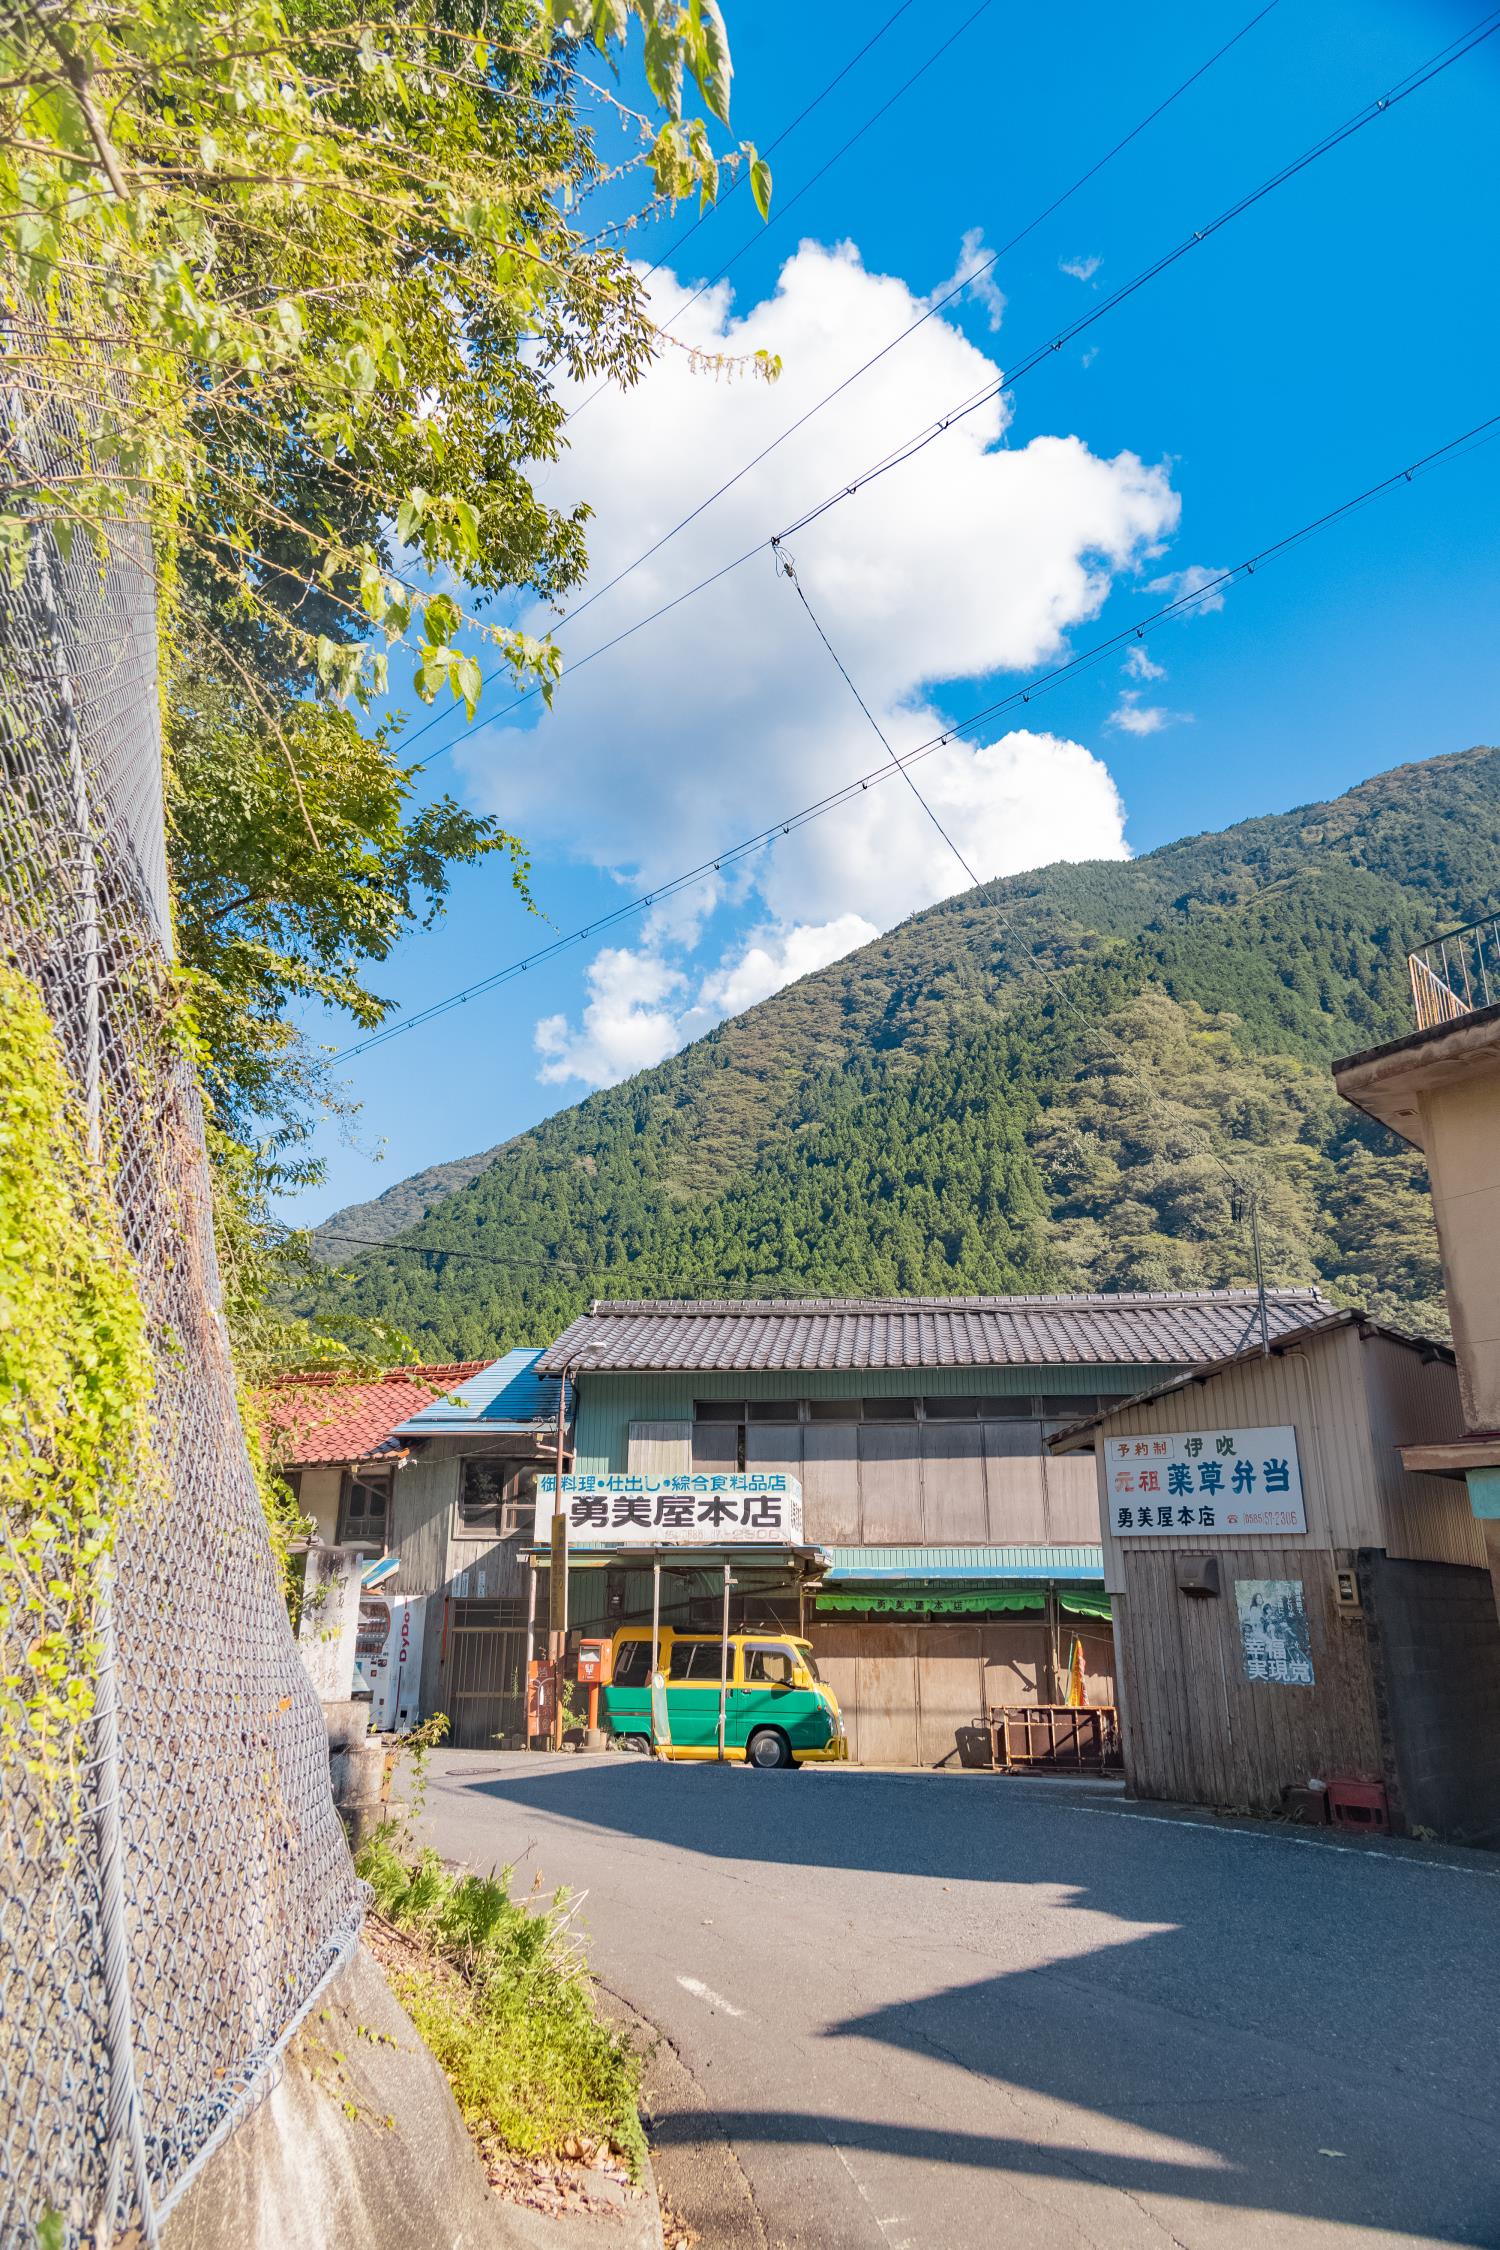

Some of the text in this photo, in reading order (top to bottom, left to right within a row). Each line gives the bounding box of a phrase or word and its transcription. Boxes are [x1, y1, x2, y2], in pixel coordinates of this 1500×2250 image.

[1117, 1441, 1167, 1458] 予約制
[1184, 1435, 1238, 1458] 伊吹
[1115, 1458, 1290, 1497] 元祖 薬草弁当
[569, 1495, 782, 1528] 勇美屋本店
[1117, 1505, 1216, 1528] 勇美屋本店
[399, 1612, 411, 1662] DyDo
[1245, 1638, 1287, 1660] 幸福
[1247, 1658, 1312, 1683] 実現党
